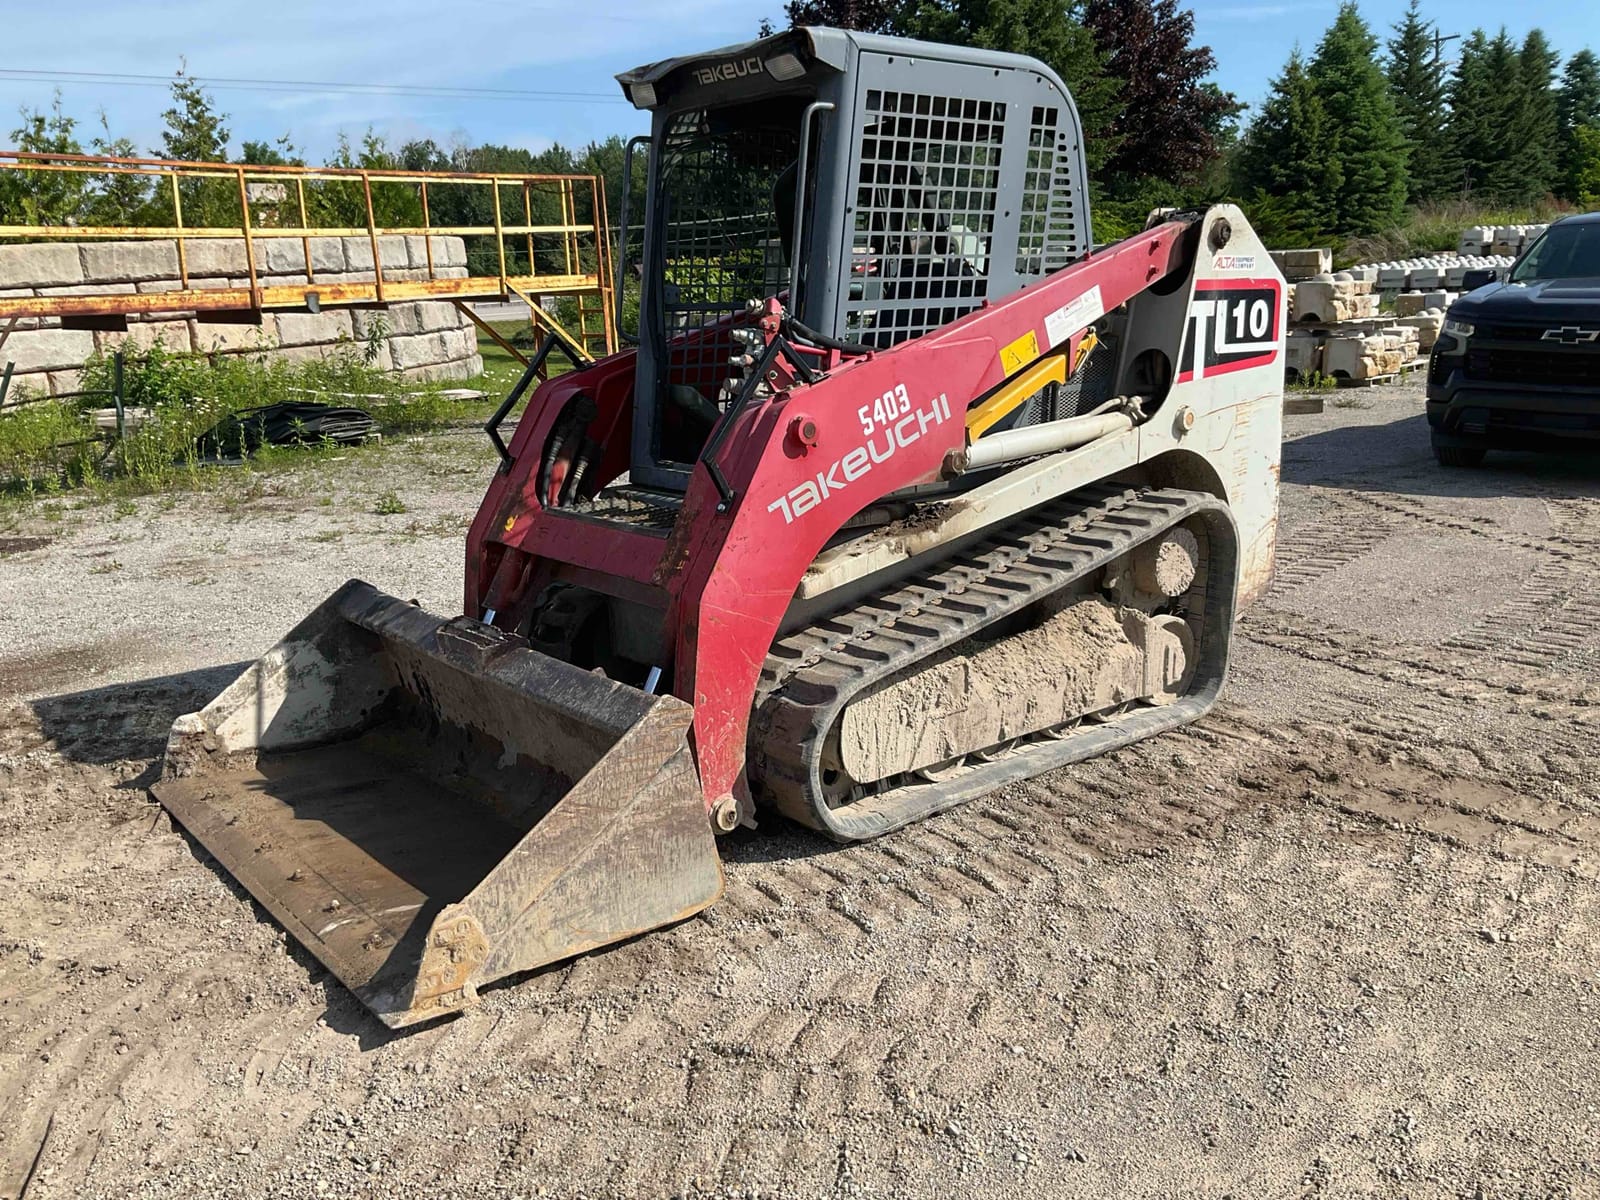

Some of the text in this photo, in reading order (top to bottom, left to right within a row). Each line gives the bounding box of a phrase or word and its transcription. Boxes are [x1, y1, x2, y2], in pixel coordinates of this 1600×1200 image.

[1213, 257, 1235, 269] ALTA
[857, 383, 911, 436] 5403
[767, 393, 952, 525] TAKEUCHI
